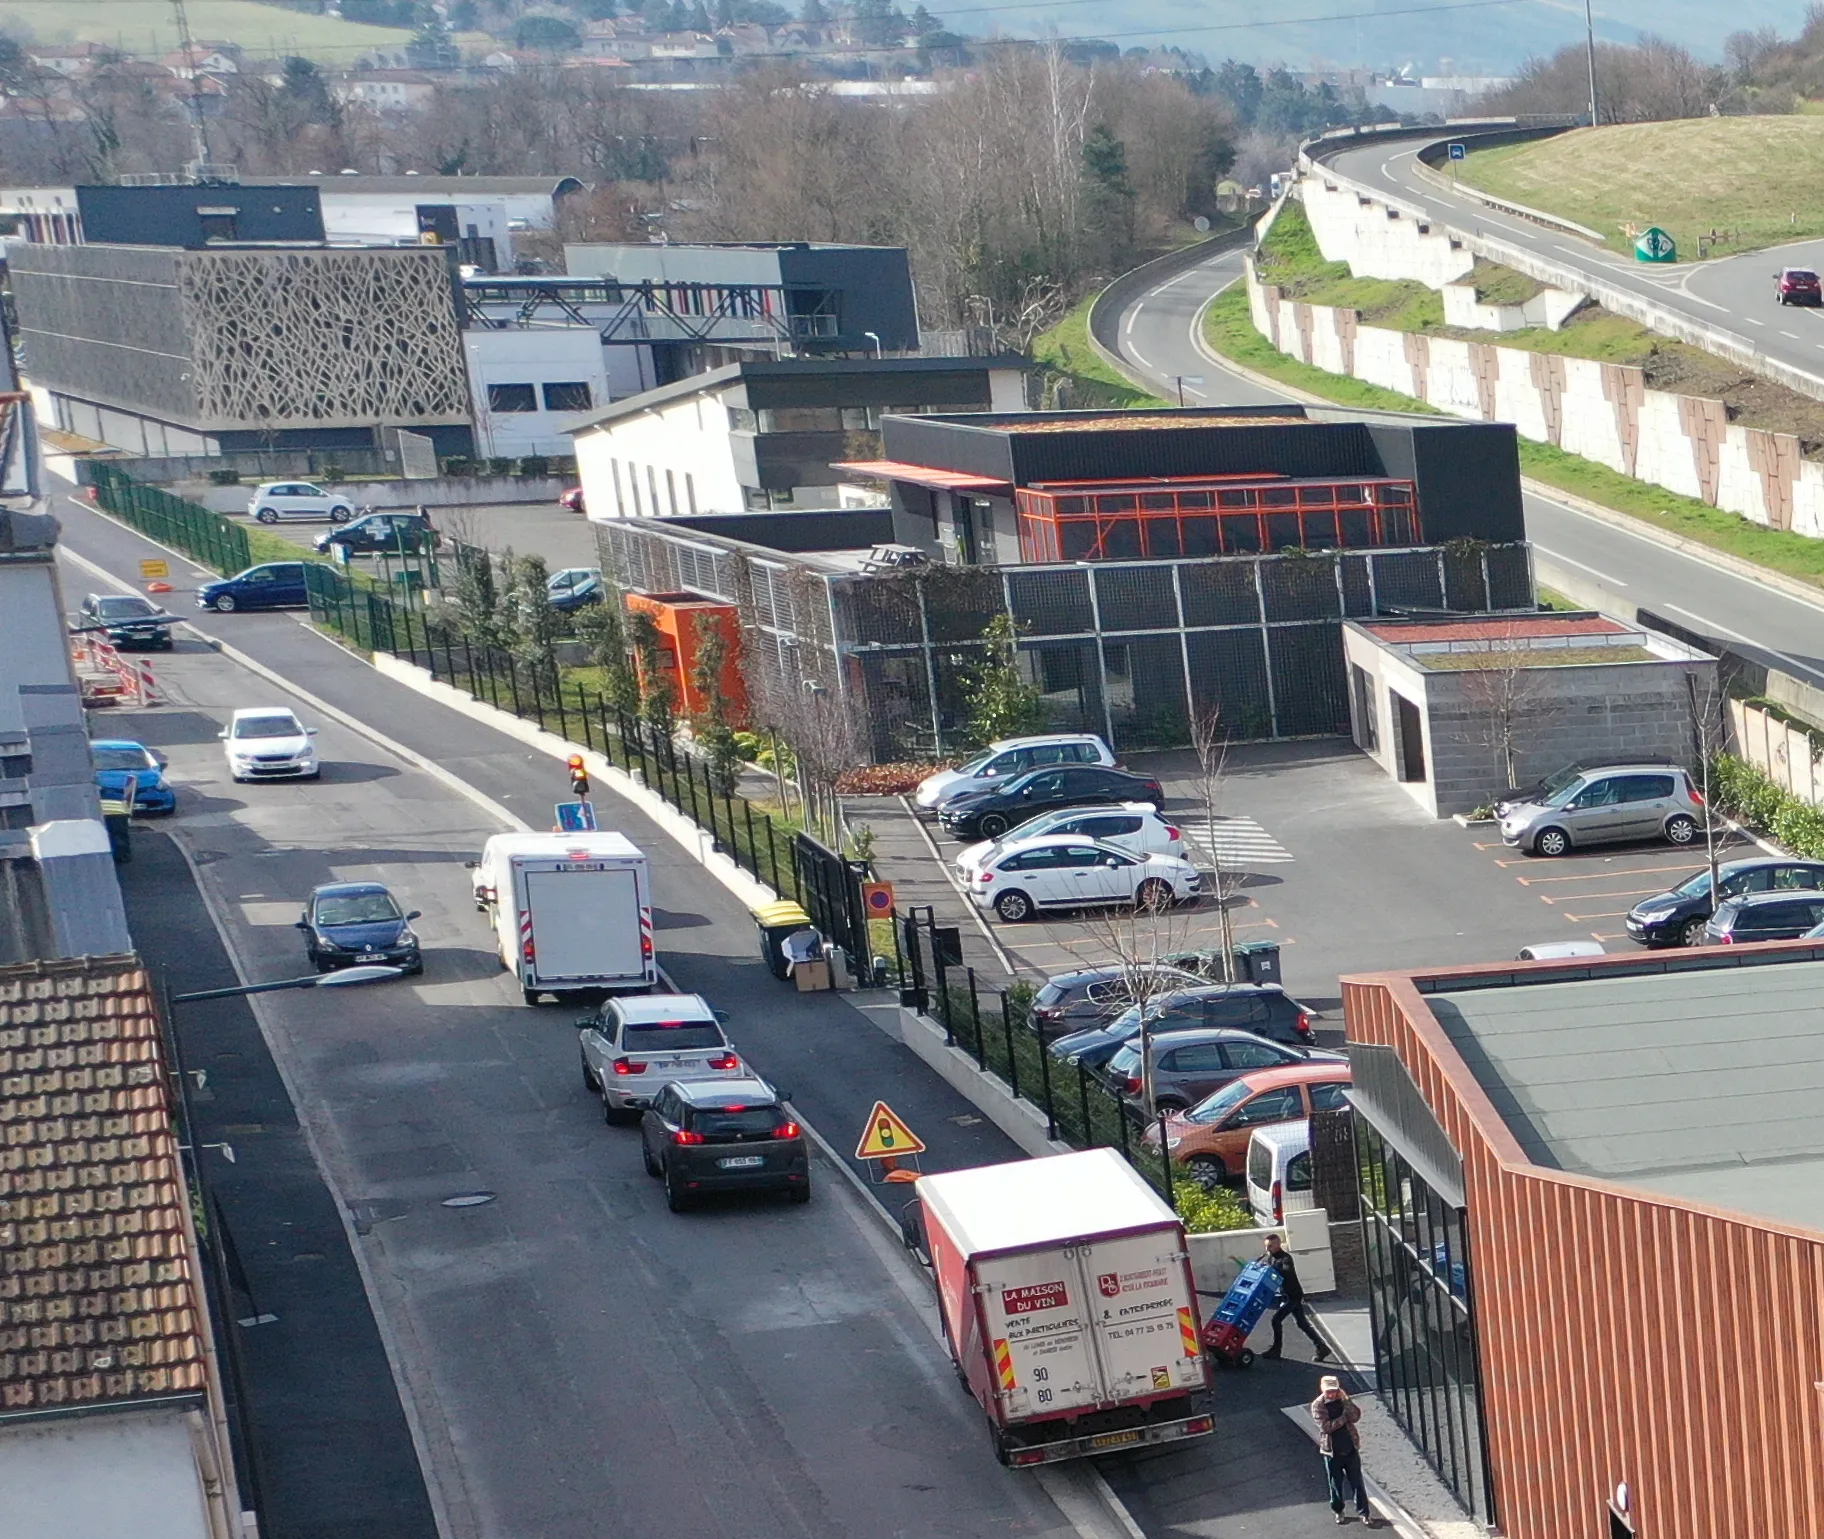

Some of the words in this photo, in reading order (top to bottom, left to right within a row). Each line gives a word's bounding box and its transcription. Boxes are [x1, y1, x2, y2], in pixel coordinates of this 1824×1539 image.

[1004, 1290, 1017, 1301] LA
[1021, 1282, 1063, 1299] MAISON
[1017, 1300, 1032, 1311] DU
[1035, 1296, 1056, 1308] VIN
[1005, 1316, 1031, 1328] VENTE
[1033, 1367, 1049, 1382] 90
[1037, 1388, 1053, 1403] 80
